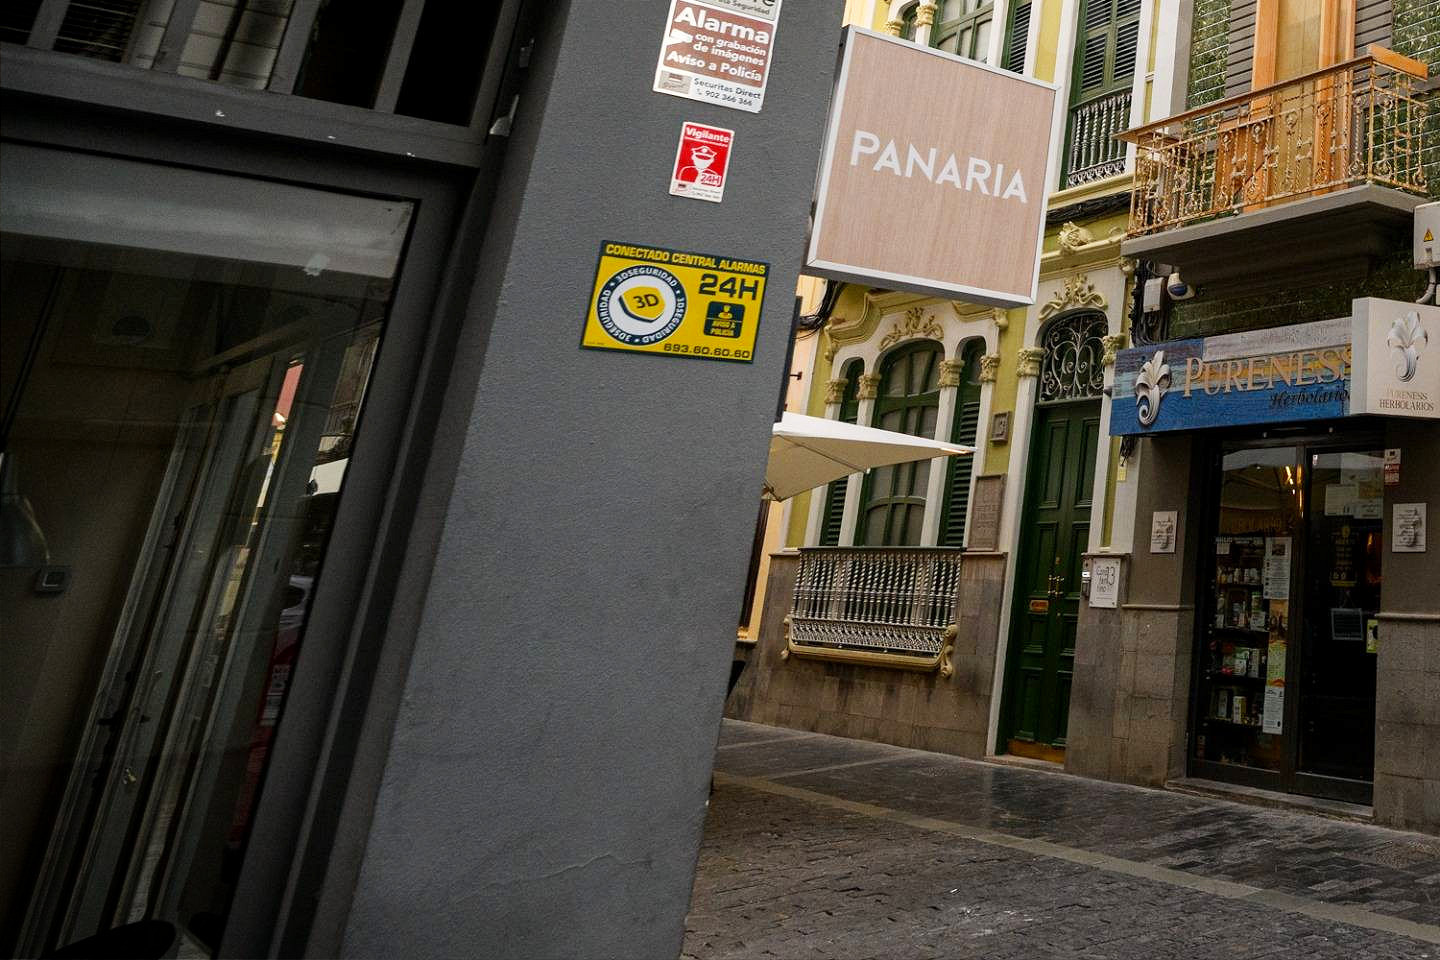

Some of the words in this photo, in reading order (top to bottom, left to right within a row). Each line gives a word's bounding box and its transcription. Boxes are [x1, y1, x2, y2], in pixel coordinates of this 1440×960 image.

[674, 6, 770, 45] Alarma
[693, 41, 709, 53] de
[711, 45, 764, 66] imágenes
[695, 33, 714, 43] con
[716, 37, 766, 56] grabación
[667, 50, 706, 68] Aviso
[708, 62, 717, 71] a
[720, 62, 762, 81] Policía
[694, 77, 733, 93] Securitas
[735, 87, 760, 100] Direct
[705, 90, 720, 99] 902
[686, 127, 730, 143] Vigilante
[850, 129, 1028, 204] PANARIA
[606, 243, 670, 262] CONECTADO
[671, 252, 717, 268] CENTRAL
[718, 259, 766, 275] ALARMAS
[698, 273, 760, 301] 24H
[633, 293, 660, 309] 3D
[1379, 399, 1435, 412] HERBOLARIOS
